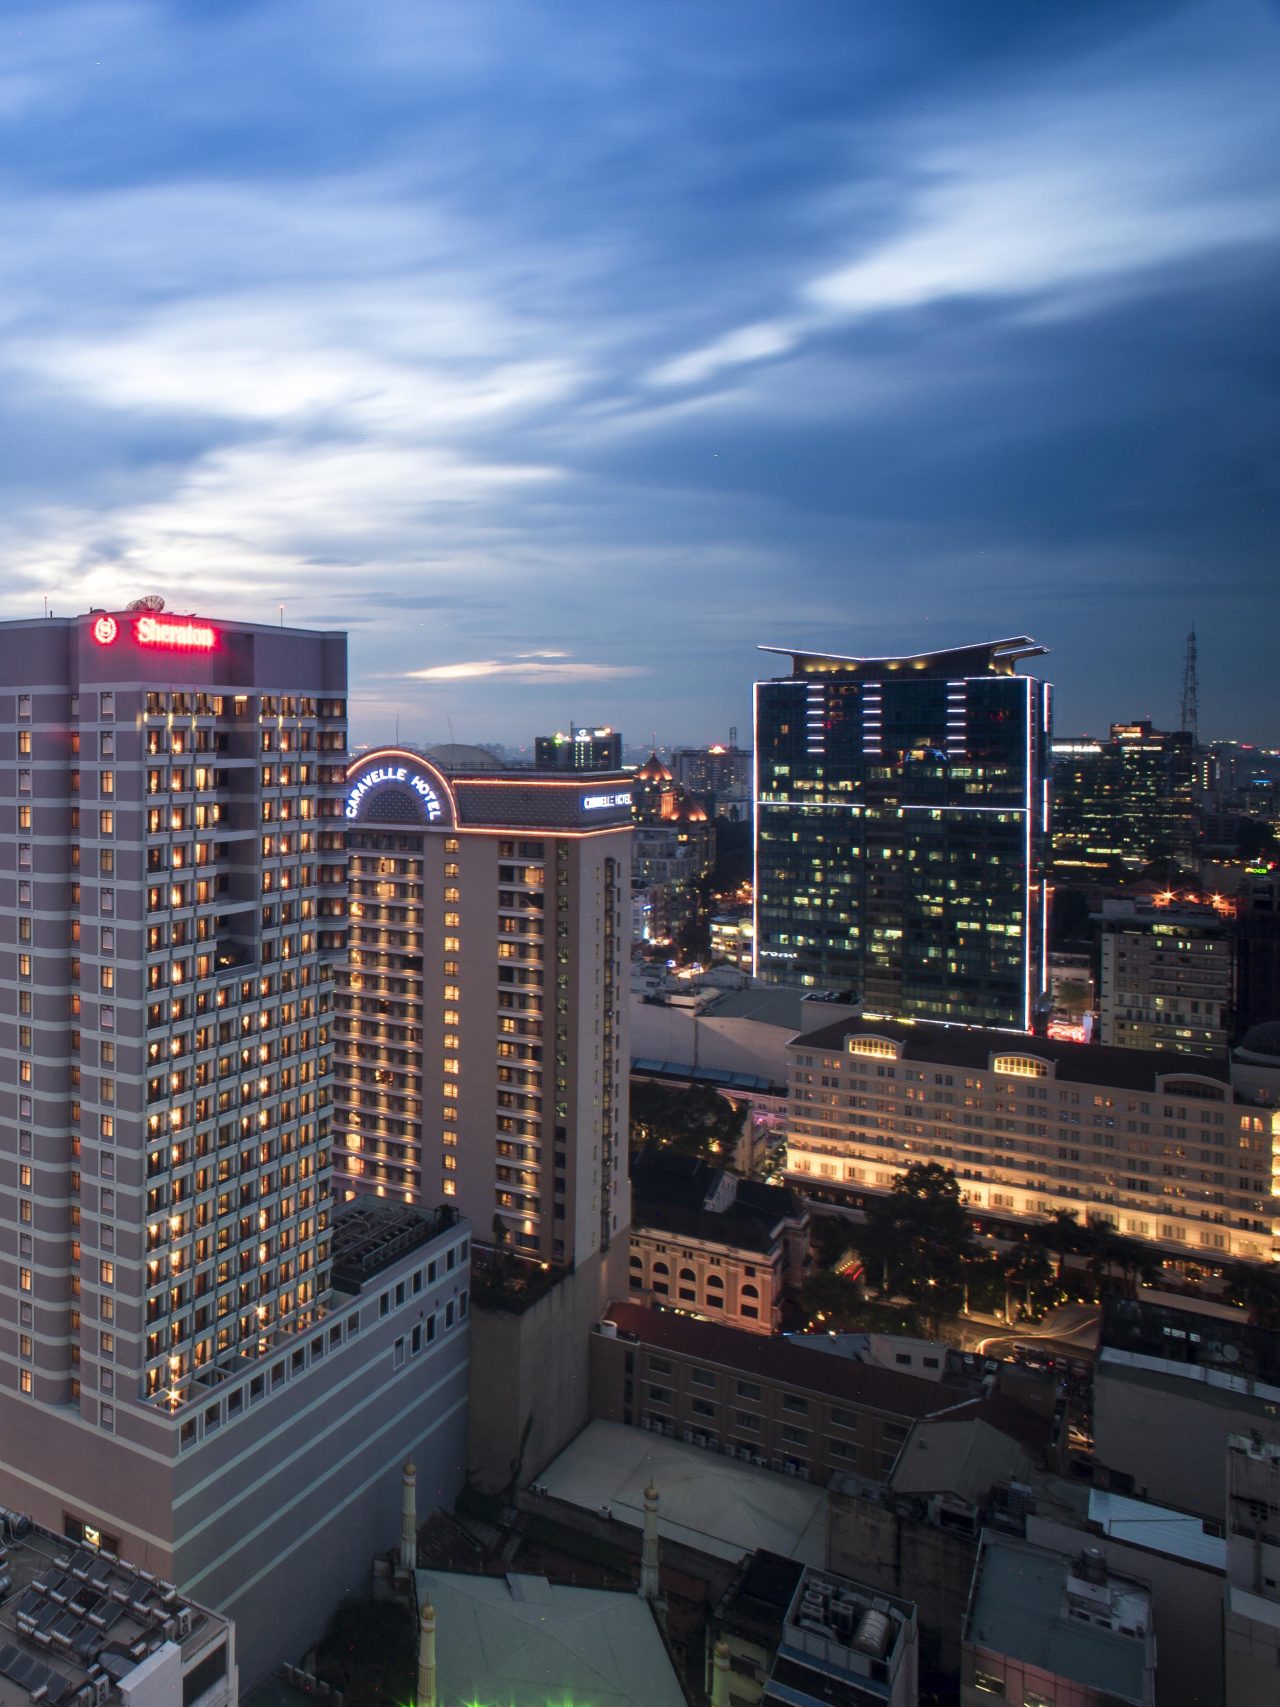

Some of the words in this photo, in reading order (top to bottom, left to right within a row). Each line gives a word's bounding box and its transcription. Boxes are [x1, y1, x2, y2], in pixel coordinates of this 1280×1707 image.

[138, 617, 213, 646] Sheraton
[345, 767, 407, 818] CARAVELLE
[410, 775, 441, 821] HOTEL
